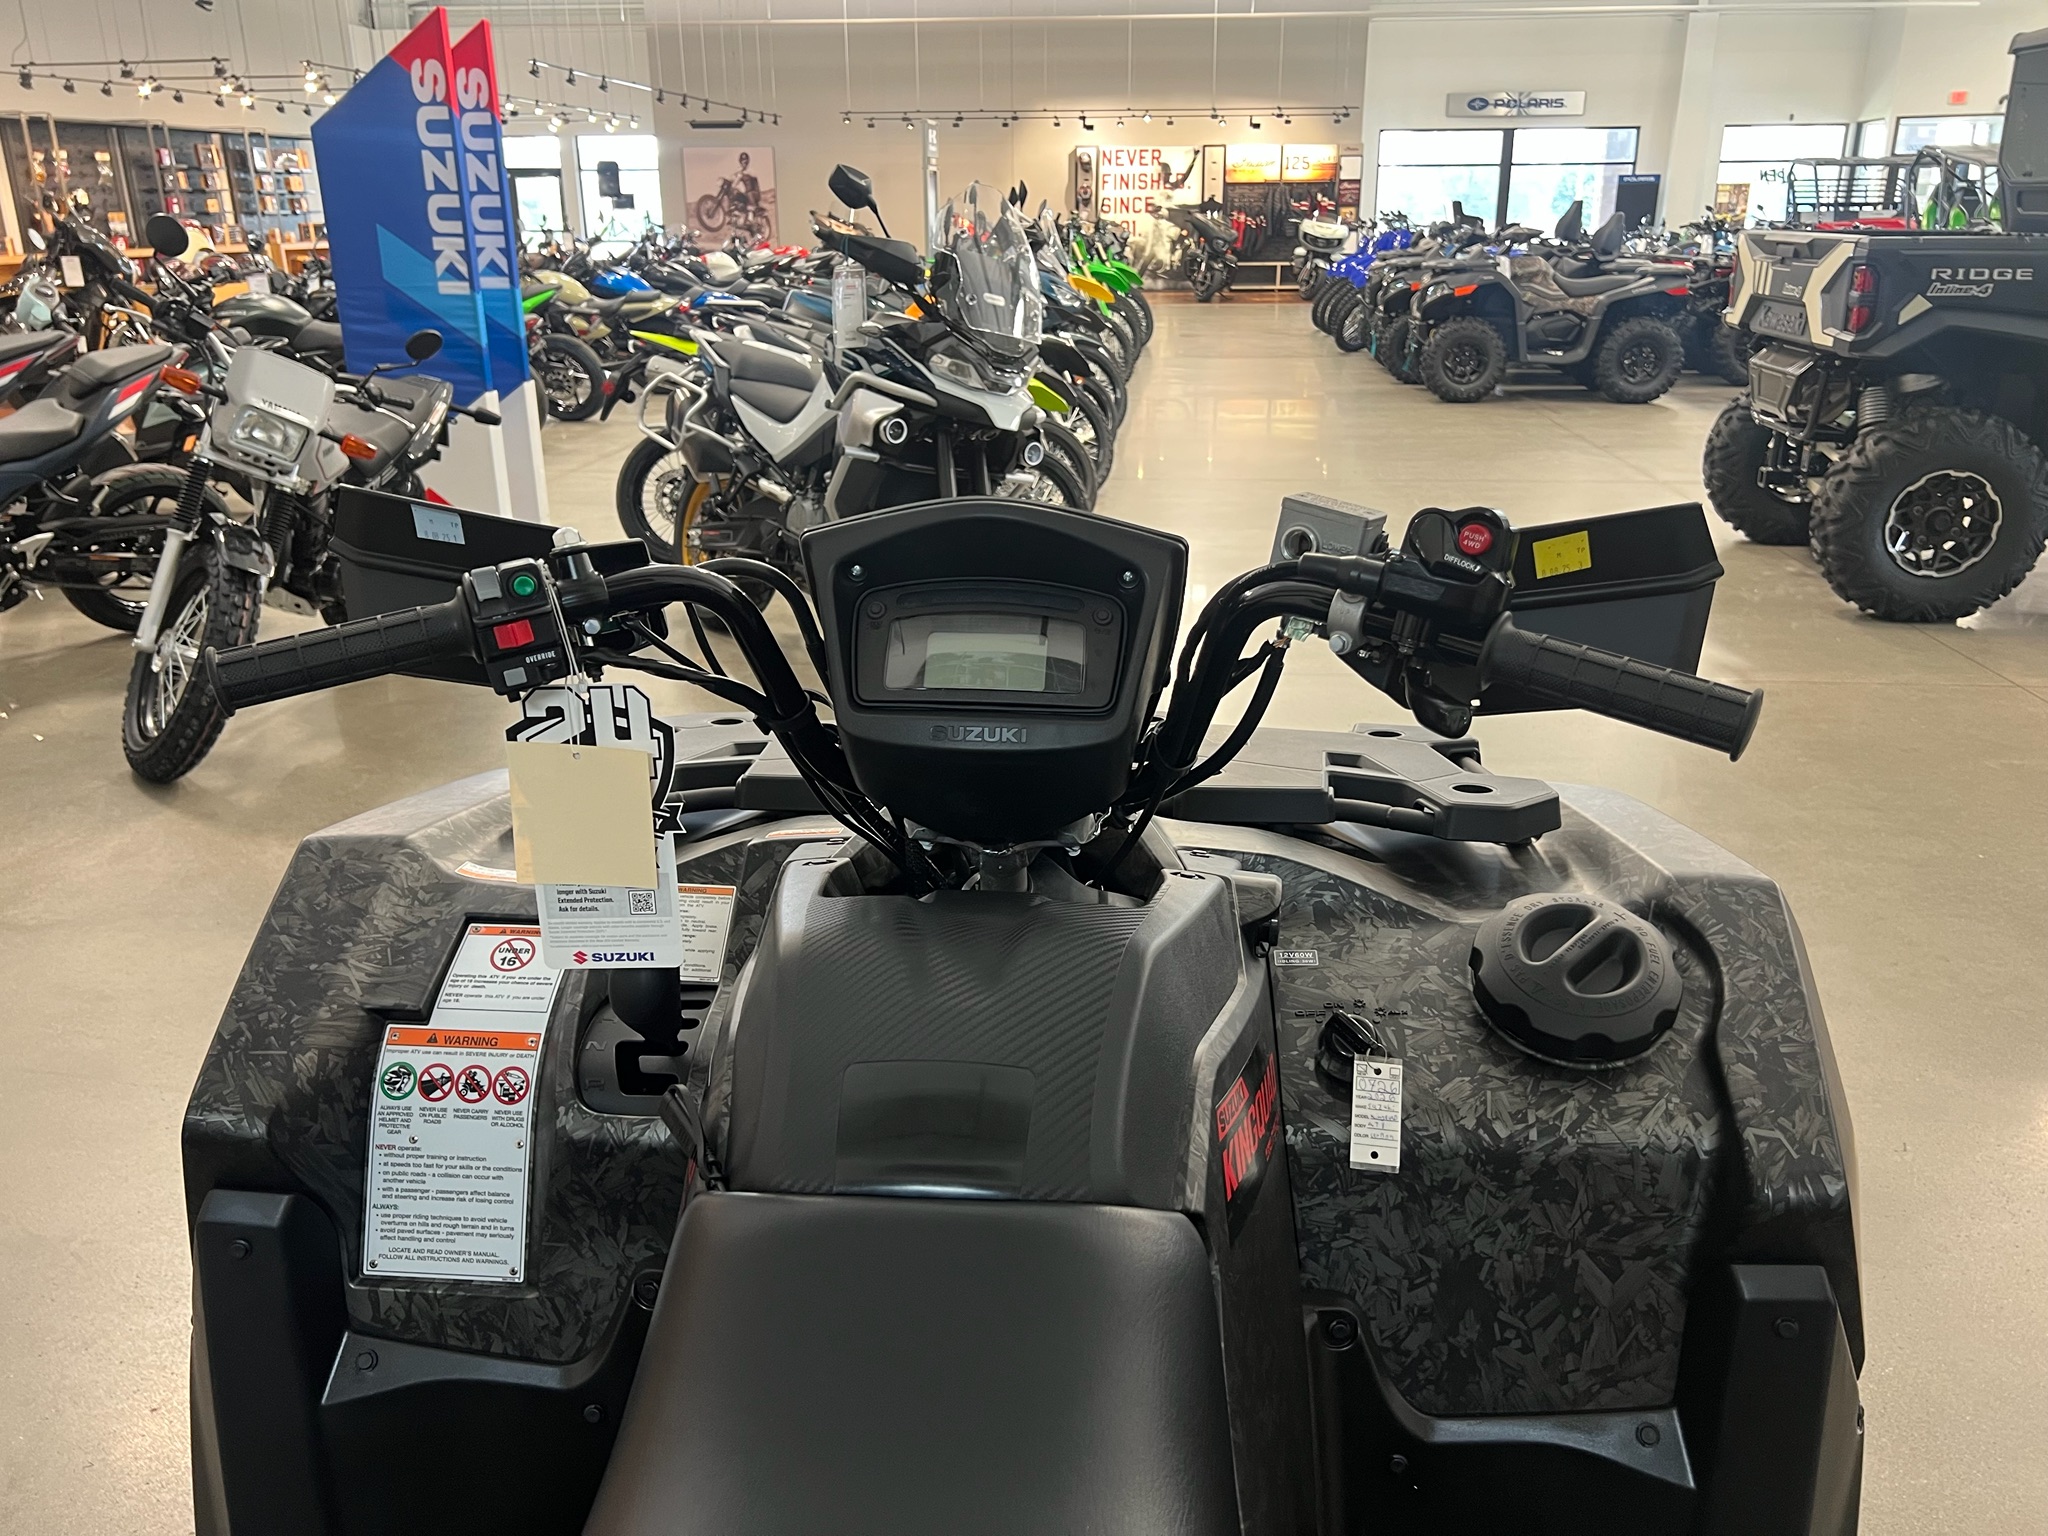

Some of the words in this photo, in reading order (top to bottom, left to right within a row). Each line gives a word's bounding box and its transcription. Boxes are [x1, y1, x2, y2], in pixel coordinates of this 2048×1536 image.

[1494, 98, 1564, 108] POLARIS
[1103, 149, 1161, 166] NEVER
[1285, 157, 1310, 170] 125
[411, 58, 470, 295] SUZUKI
[456, 68, 510, 289] SUZUKI
[1101, 197, 1155, 214] SINCE
[1930, 268, 2034, 280] RIDGE
[1463, 531, 1485, 542] PUSH
[1462, 540, 1481, 549] 4WD
[525, 650, 556, 664] OVERRIDE
[930, 726, 1027, 743] SUZUKI
[1634, 925, 1648, 937] NO
[1646, 942, 1661, 966] FUEL
[500, 957, 517, 966] 16
[591, 952, 655, 962] SUZUKI
[444, 1035, 498, 1047] WARNING
[1219, 1081, 1246, 1133] SUZUKI
[1223, 1053, 1277, 1202] KINGQUAD
[489, 1232, 514, 1240] seriously
